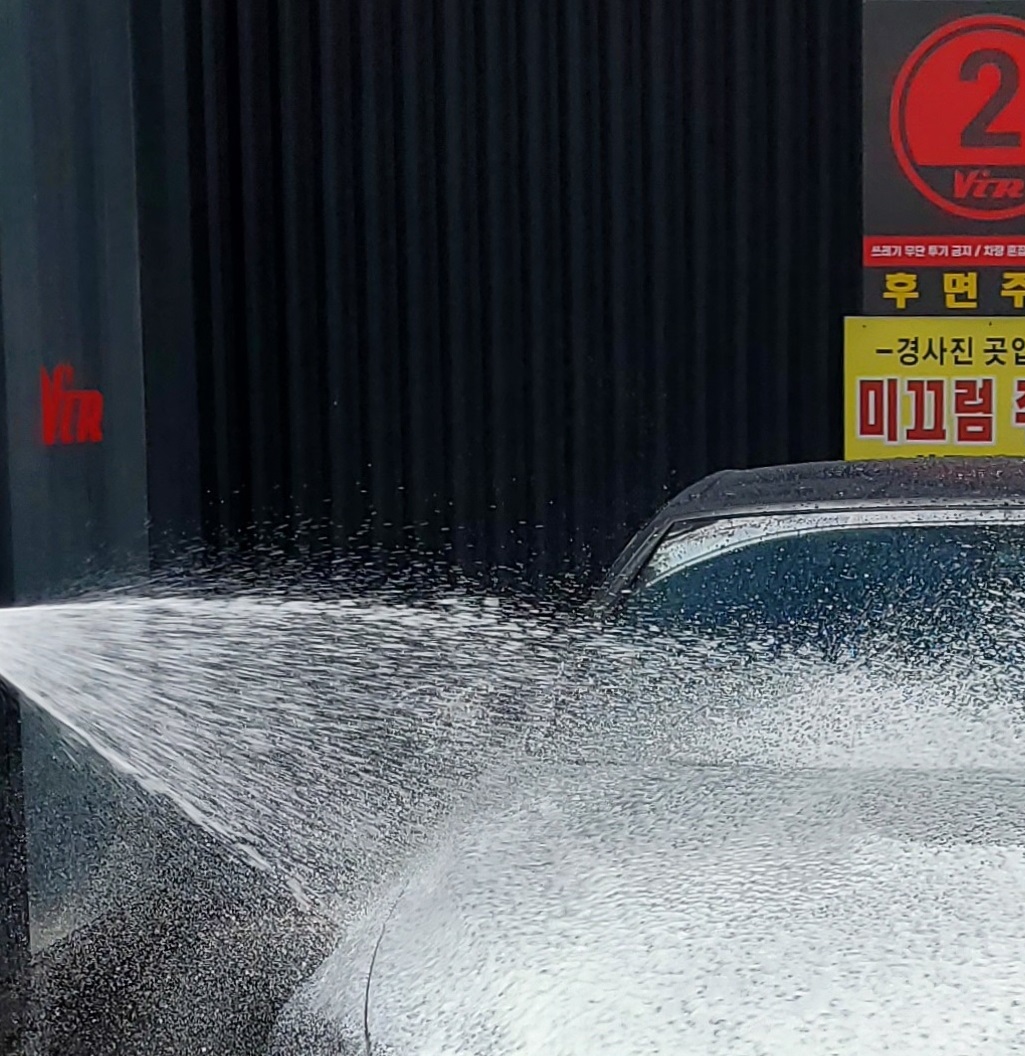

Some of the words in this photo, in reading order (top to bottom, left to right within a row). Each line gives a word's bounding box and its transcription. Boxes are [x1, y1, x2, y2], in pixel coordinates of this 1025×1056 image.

[959, 48, 1021, 147] 2
[870, 244, 901, 257] 쓰레기
[904, 244, 926, 257] 무단
[928, 244, 948, 257] 투기
[951, 244, 972, 258] 금지
[983, 244, 1004, 257] 차량
[859, 378, 996, 442] 미끄럼
